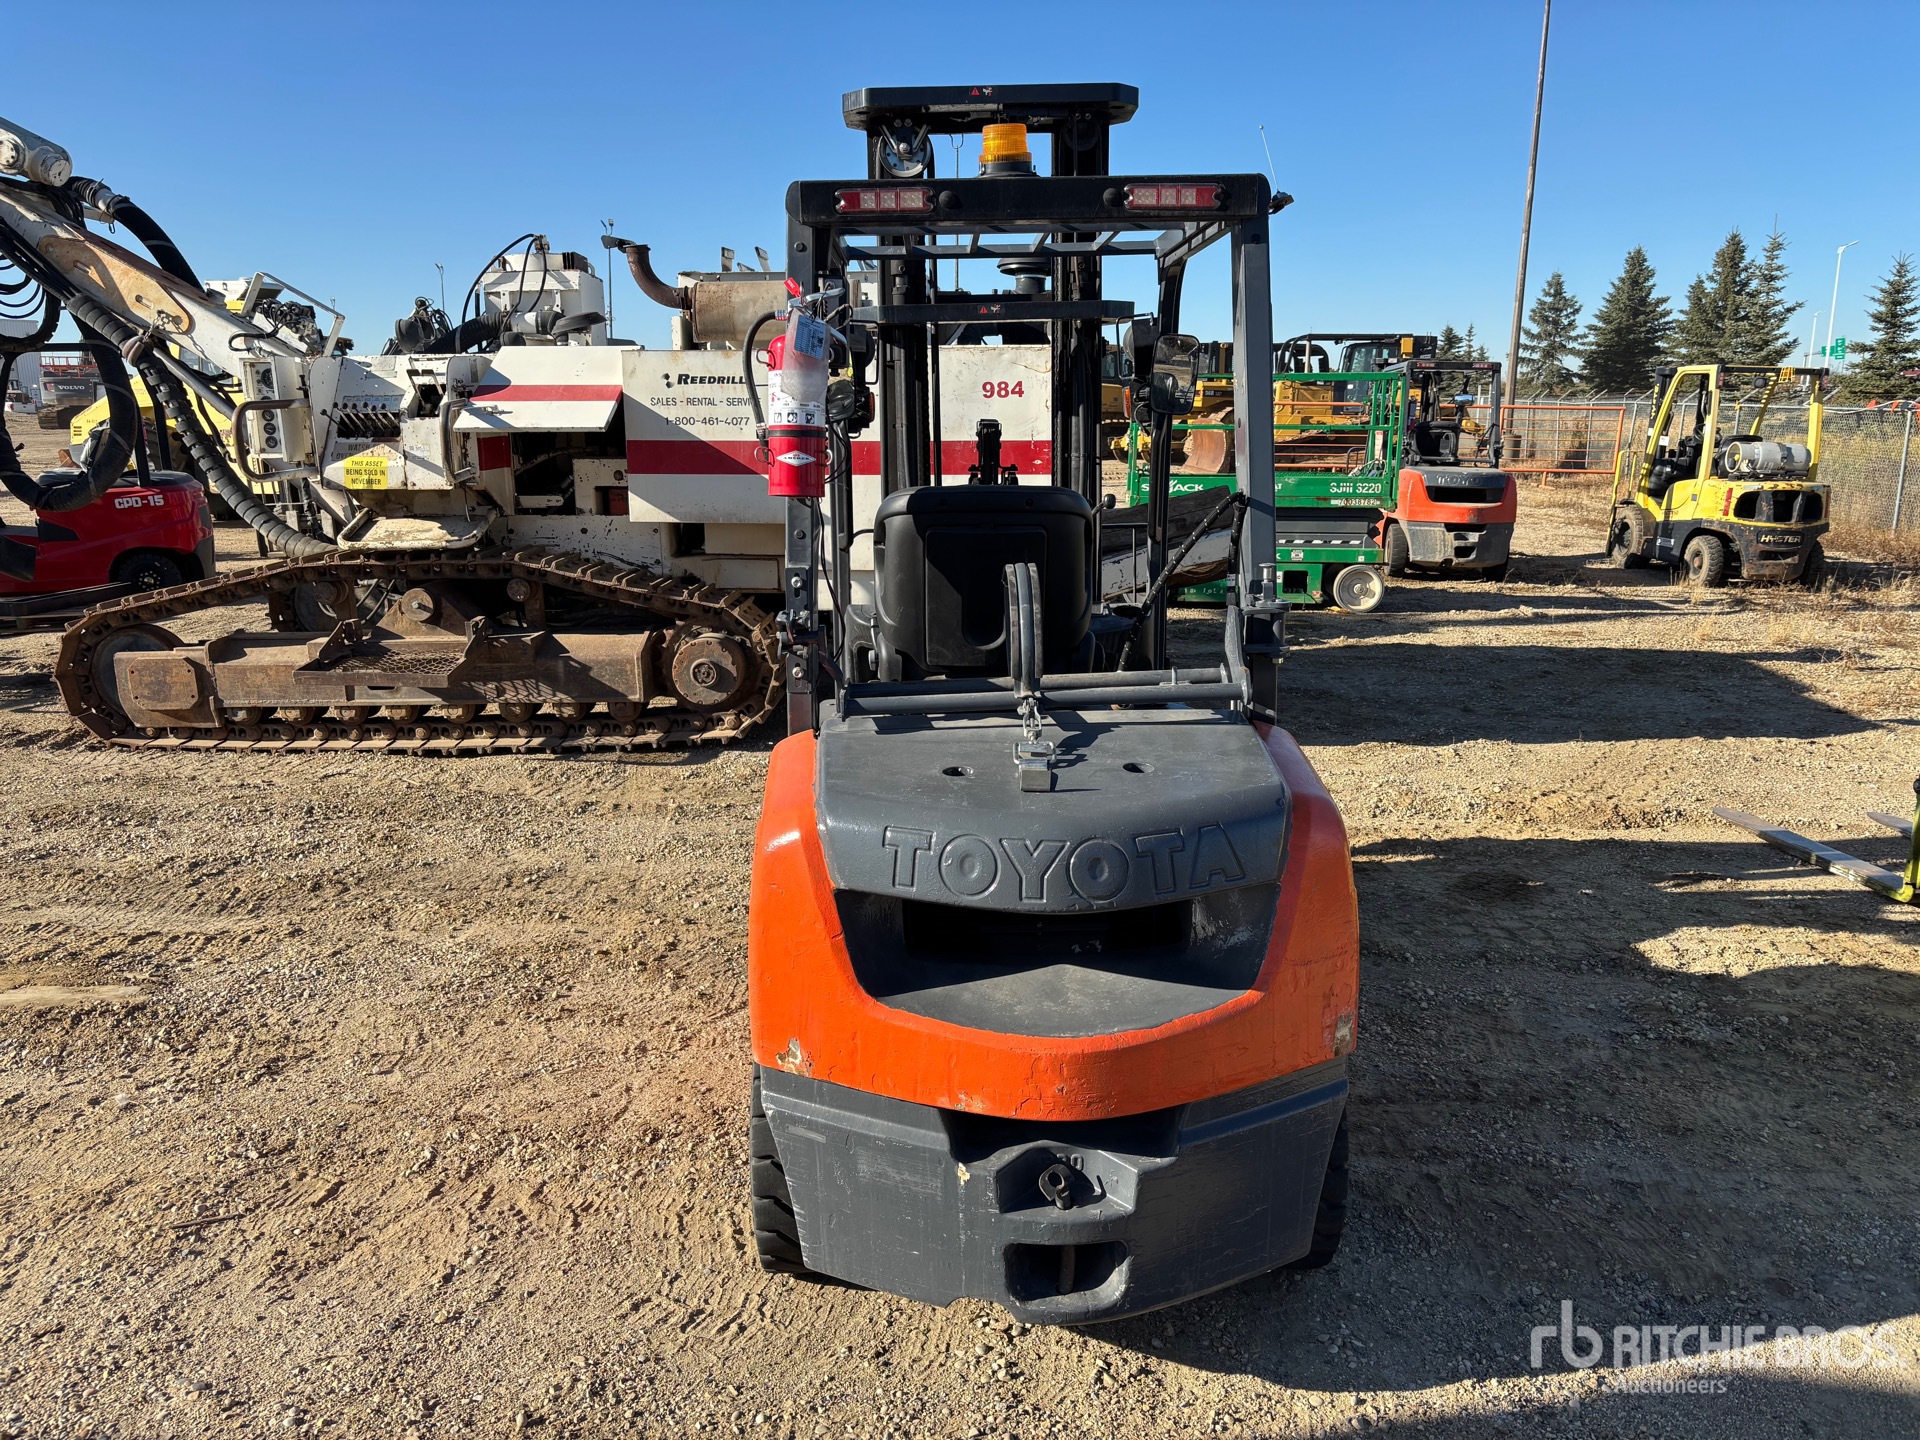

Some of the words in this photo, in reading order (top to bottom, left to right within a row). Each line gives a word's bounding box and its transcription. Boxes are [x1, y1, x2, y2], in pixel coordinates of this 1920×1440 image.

[677, 374, 747, 385] REEDRILL
[982, 380, 1025, 398] 984
[650, 397, 677, 406] SALES
[686, 397, 717, 406] RENTAL
[726, 397, 761, 406] SERVI
[665, 416, 750, 426] 1-800-461-4077
[364, 468, 378, 476] SOLD
[1141, 480, 1204, 493] SJACK
[1356, 483, 1382, 494] 3220
[114, 494, 165, 509] CPD-15
[1760, 534, 1802, 543] HYSTER
[882, 821, 1246, 904] TOYOTA
